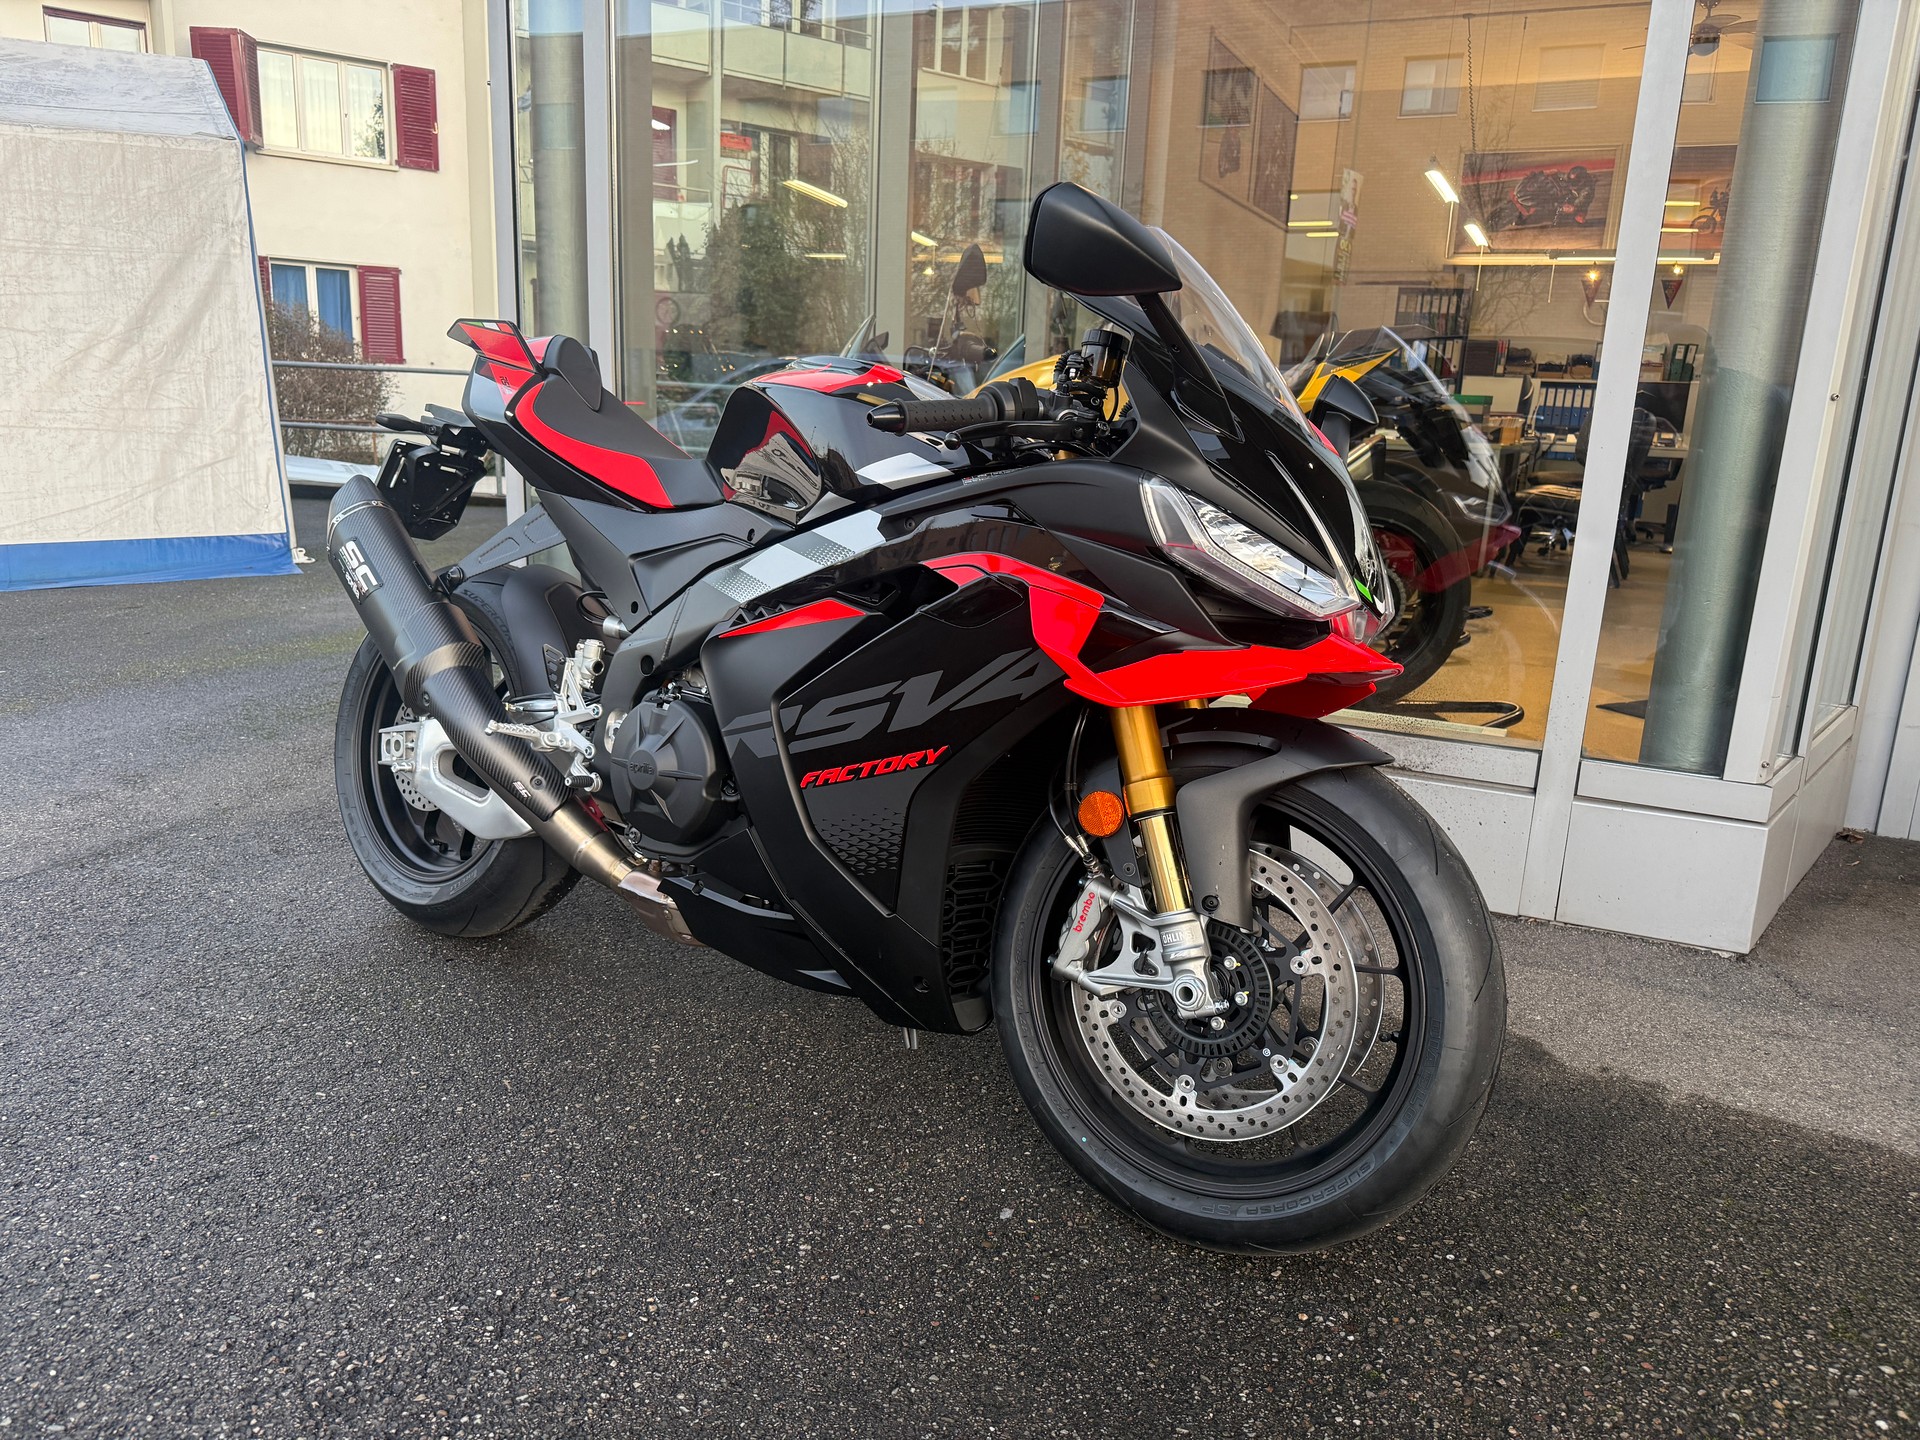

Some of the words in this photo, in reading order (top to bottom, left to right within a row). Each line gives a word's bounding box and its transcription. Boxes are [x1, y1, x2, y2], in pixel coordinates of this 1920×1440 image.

[722, 647, 1066, 759] RSV4
[800, 745, 949, 789] FACTORY
[1073, 891, 1096, 933] brembo
[1200, 1203, 1232, 1217] SP
[1246, 1161, 1373, 1216] SUPERCORSA
